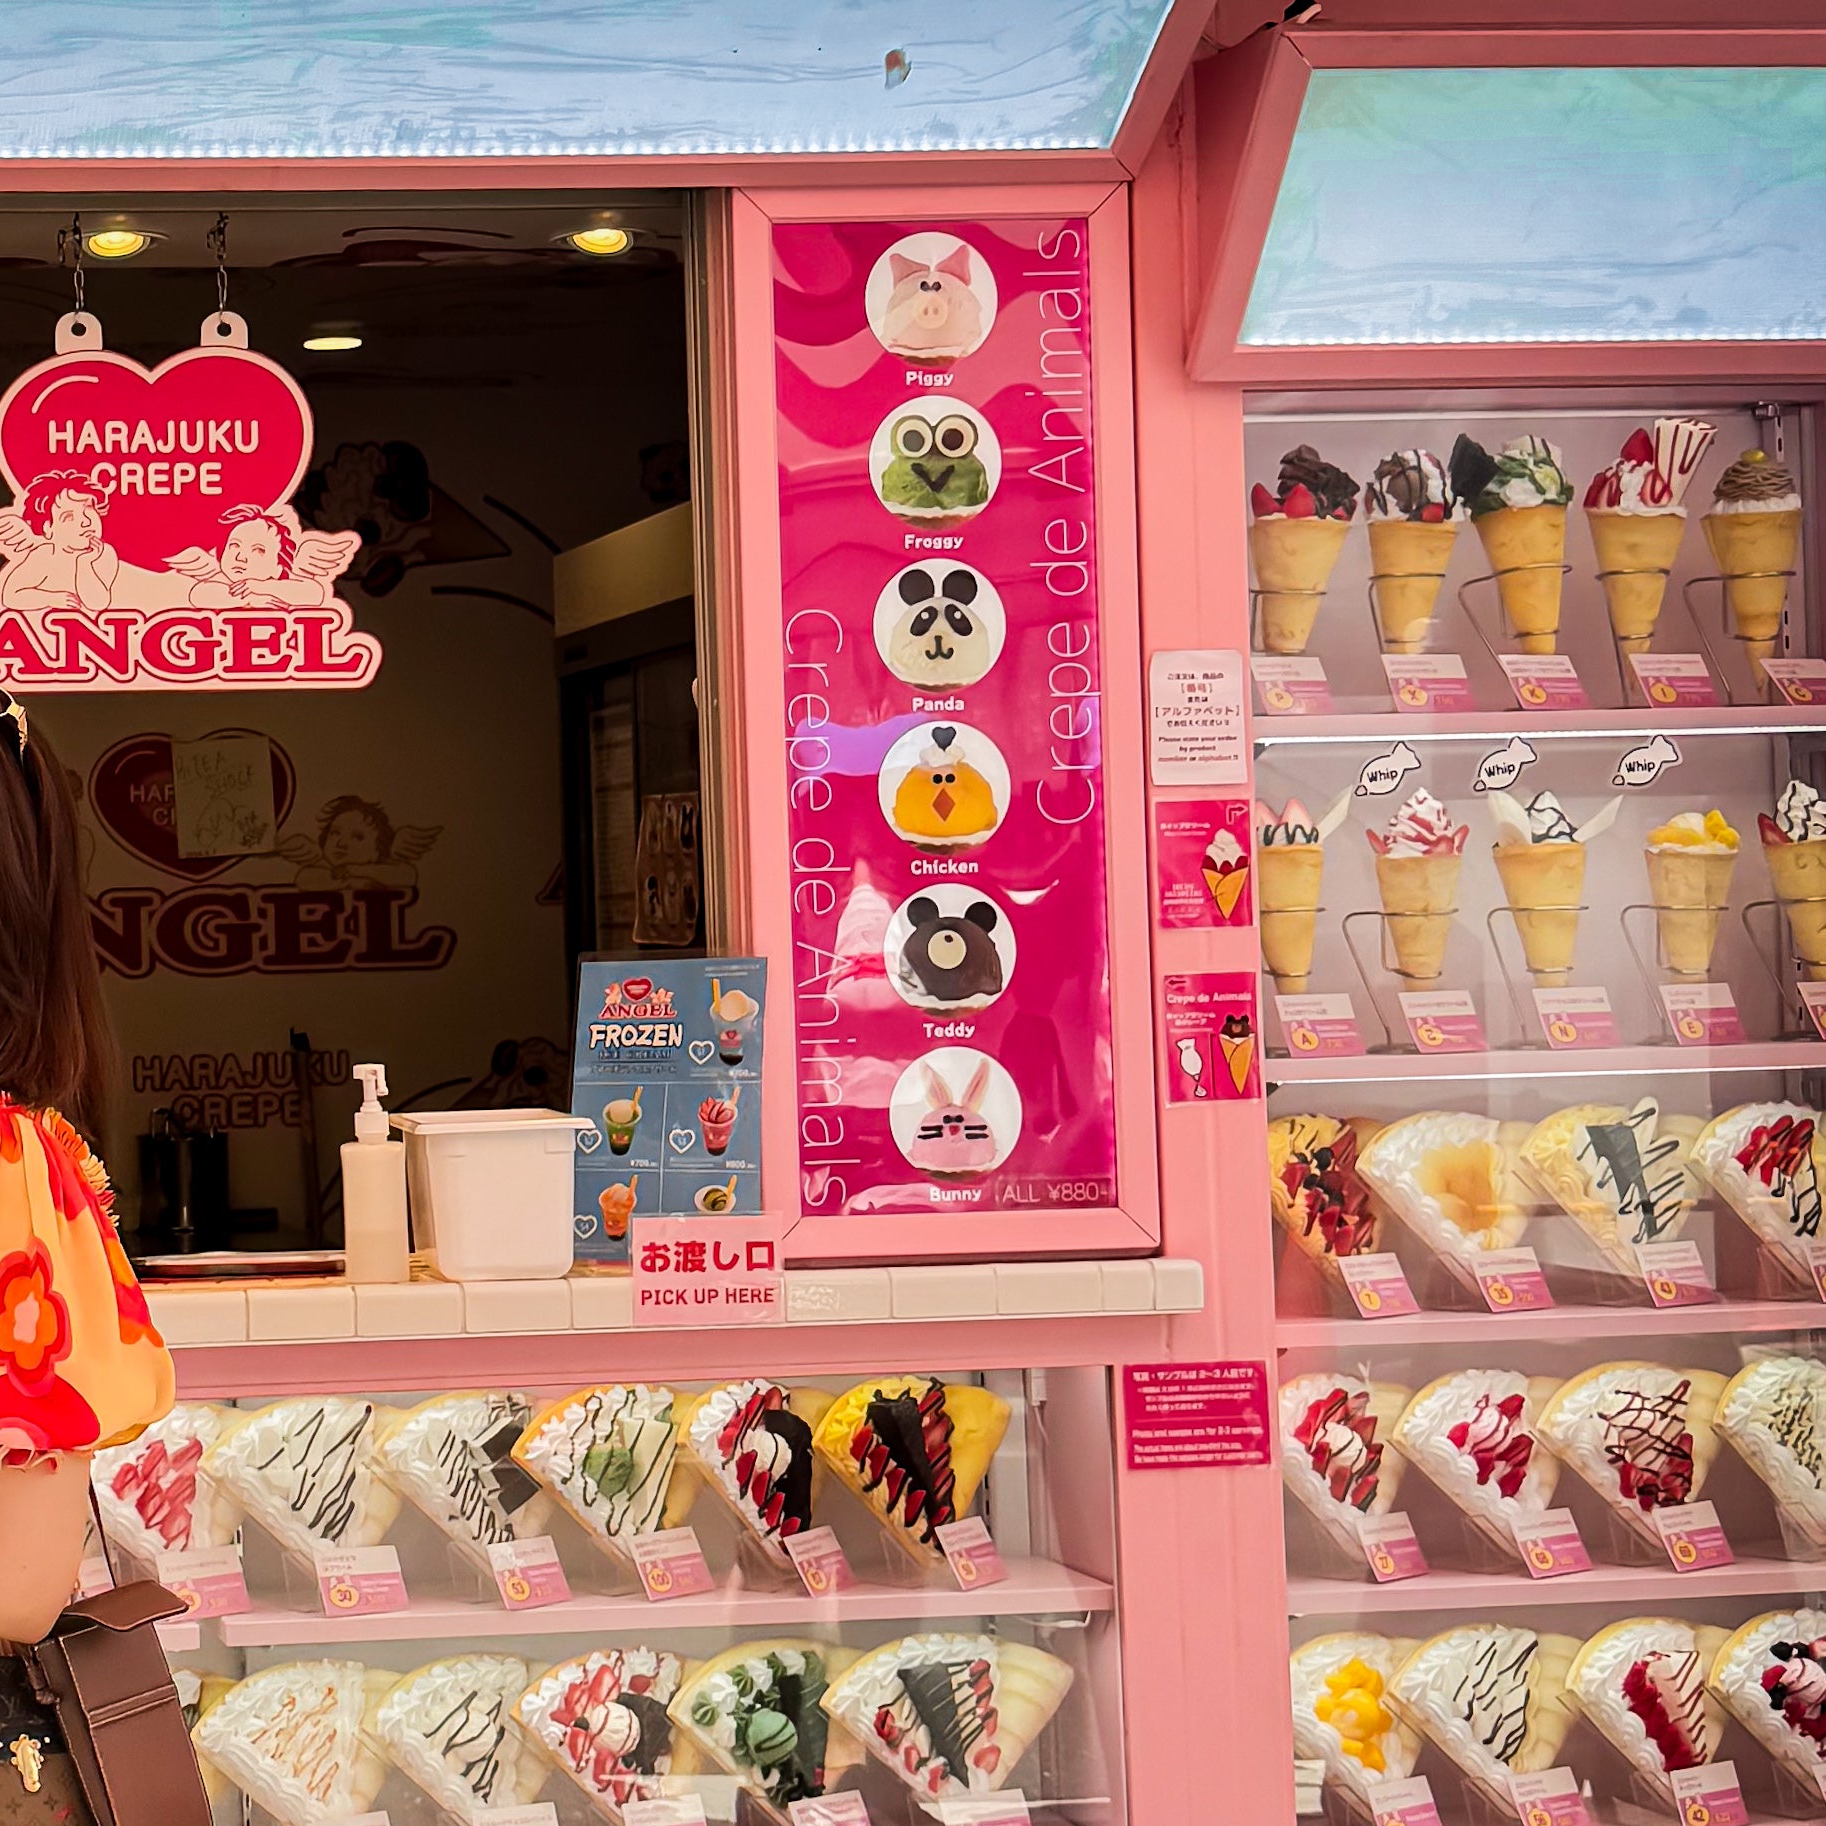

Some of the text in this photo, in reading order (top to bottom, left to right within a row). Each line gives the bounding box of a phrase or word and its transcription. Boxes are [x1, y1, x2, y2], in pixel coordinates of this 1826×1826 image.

[905, 370, 954, 388] Piggy
[48, 419, 260, 454] HARAJUKU
[91, 461, 223, 496] CREPE
[1024, 228, 1102, 825] Crepe de Animals
[903, 534, 964, 551] Froggy
[911, 697, 965, 712] Panda
[1484, 763, 1515, 778] Whip
[1625, 759, 1656, 774] Whip
[1366, 769, 1398, 783] Whip
[910, 859, 979, 875] Chicken
[784, 608, 862, 1208] Crepe de Animals
[90, 883, 458, 979] NGEL
[598, 1003, 678, 1020] ANGEL
[589, 1023, 684, 1050] FROZEN
[922, 1022, 976, 1039] Teddy
[929, 1187, 982, 1204] Bunny
[1001, 1183, 1041, 1203] ALL
[639, 1240, 775, 1273] お渡し口
[641, 1287, 775, 1306] PICK UP HERE
